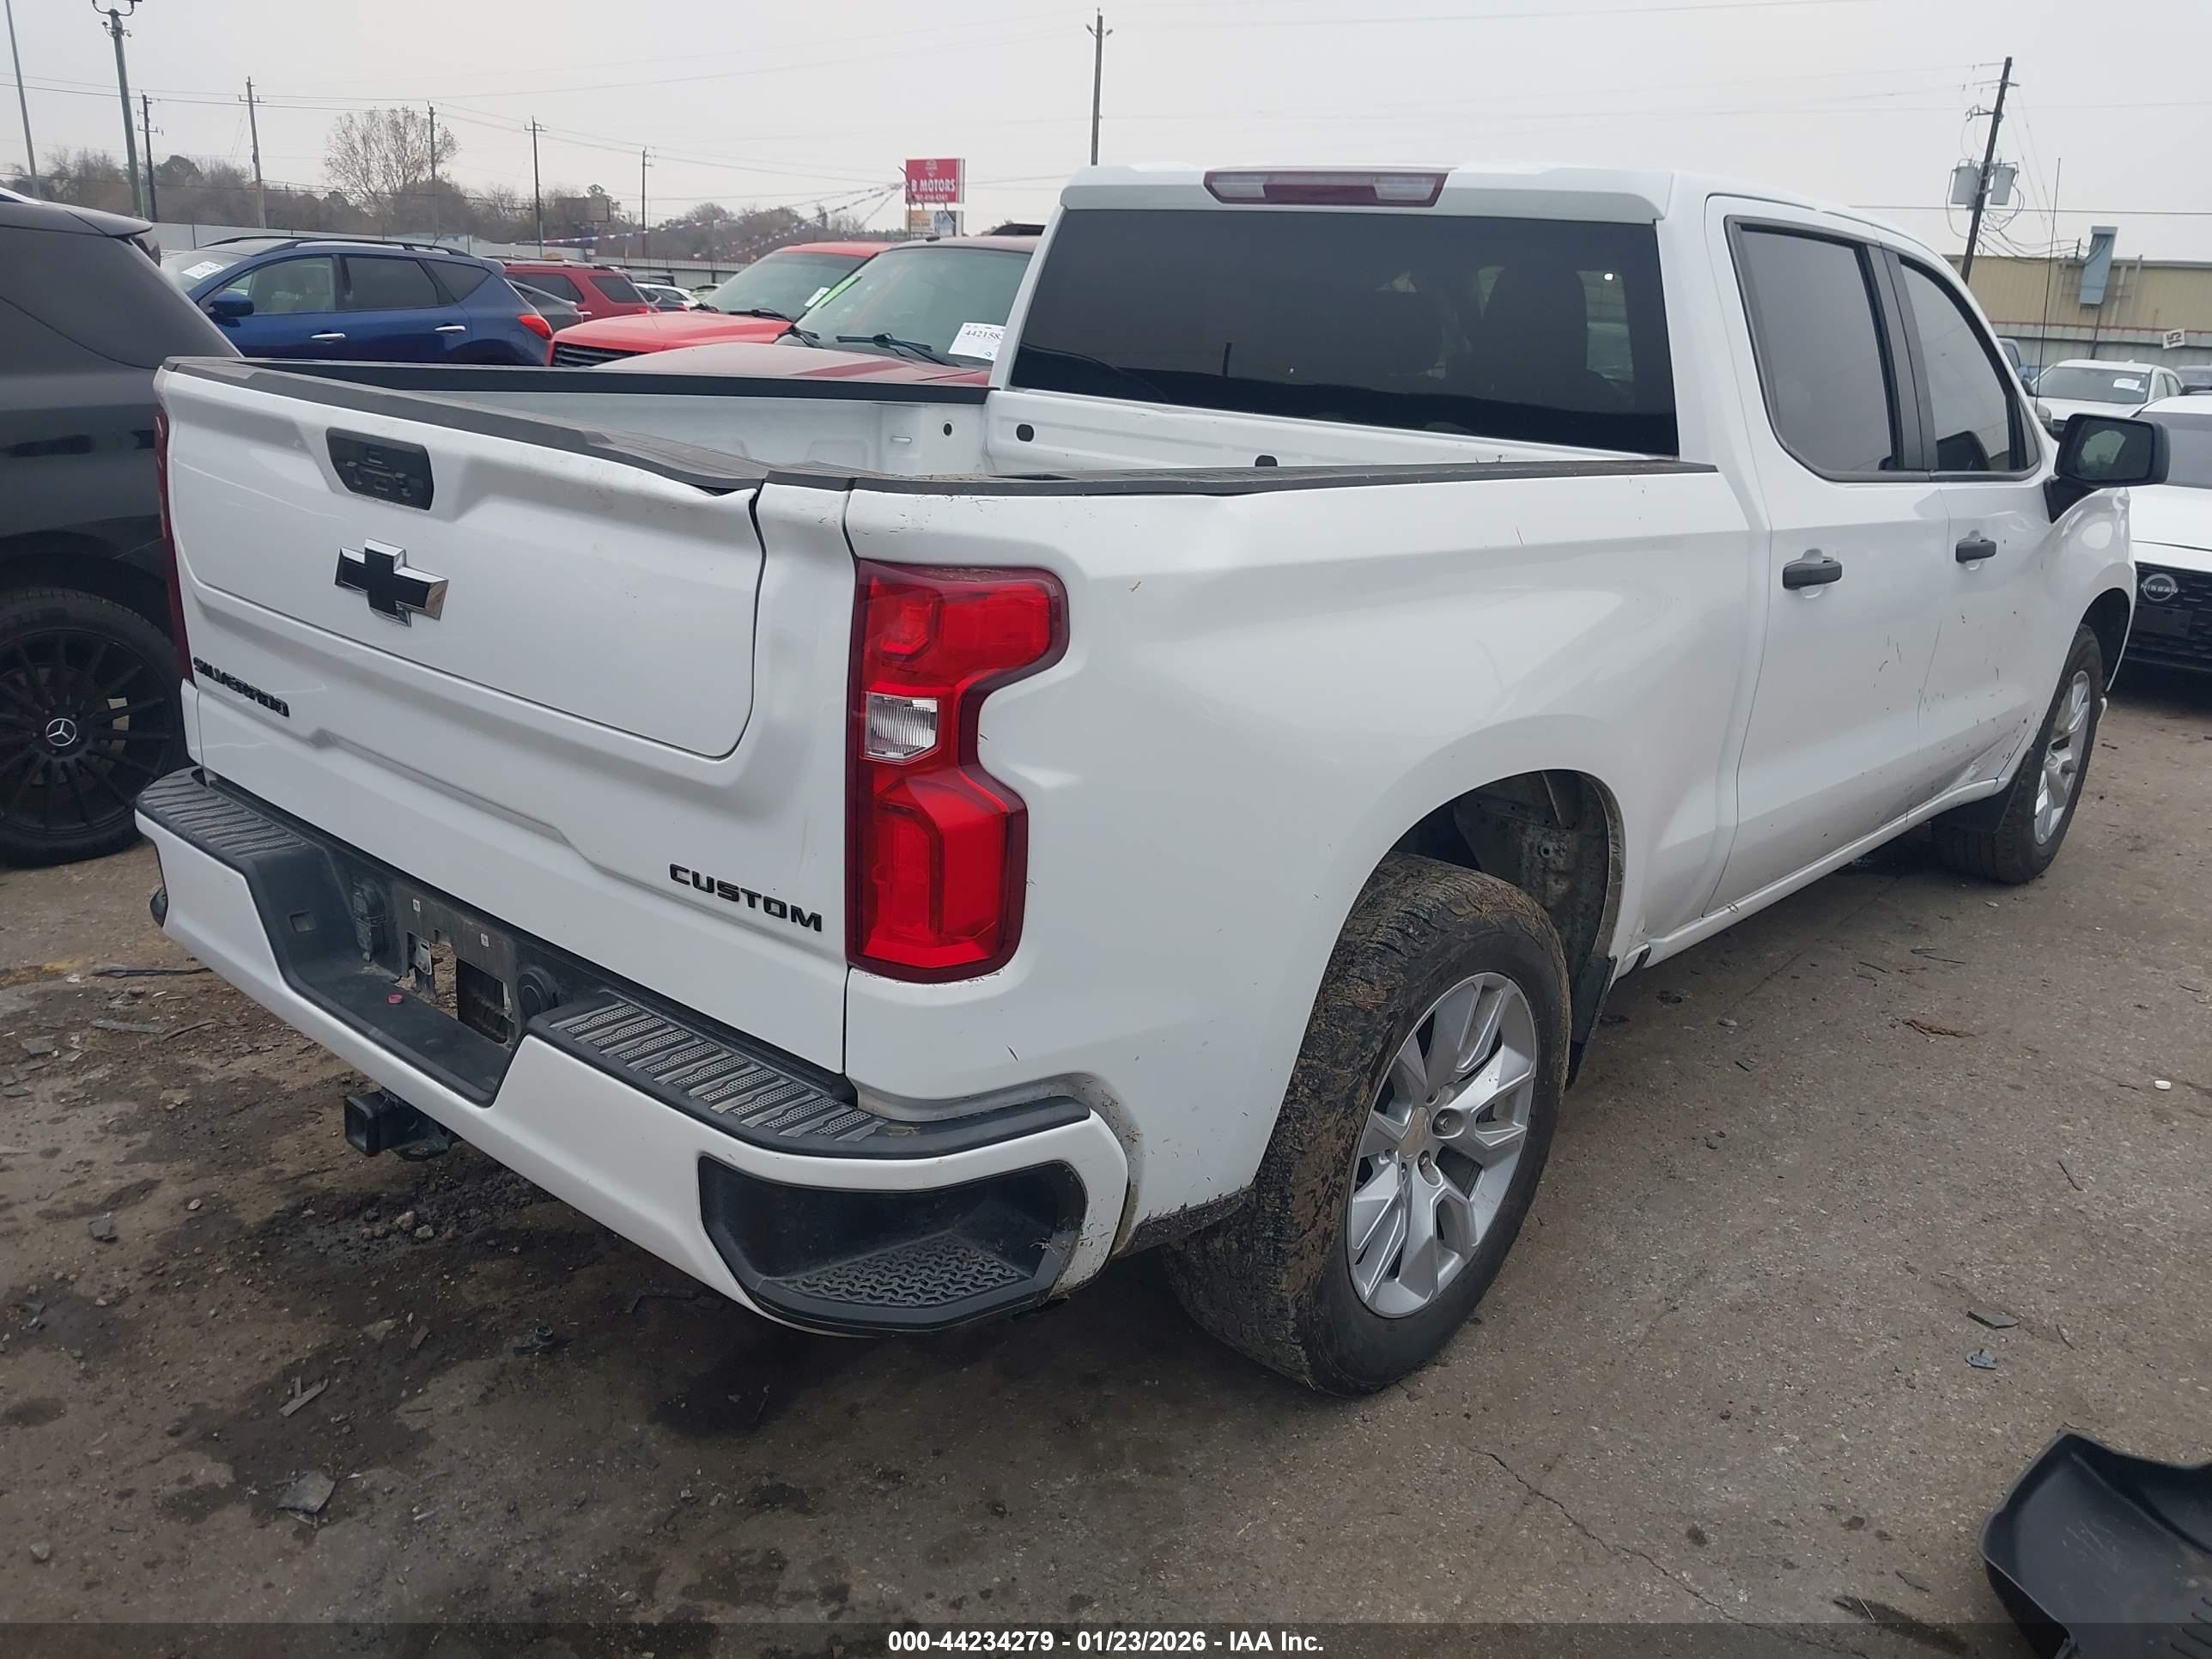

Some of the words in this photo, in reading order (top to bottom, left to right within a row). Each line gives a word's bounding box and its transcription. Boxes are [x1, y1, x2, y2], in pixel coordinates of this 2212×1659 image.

[920, 178, 956, 192] MOTORS
[2166, 331, 2182, 345] 15
[2140, 584, 2179, 594] NISSAN
[193, 657, 289, 717] SILVERADO
[670, 863, 823, 933] CUSTOM
